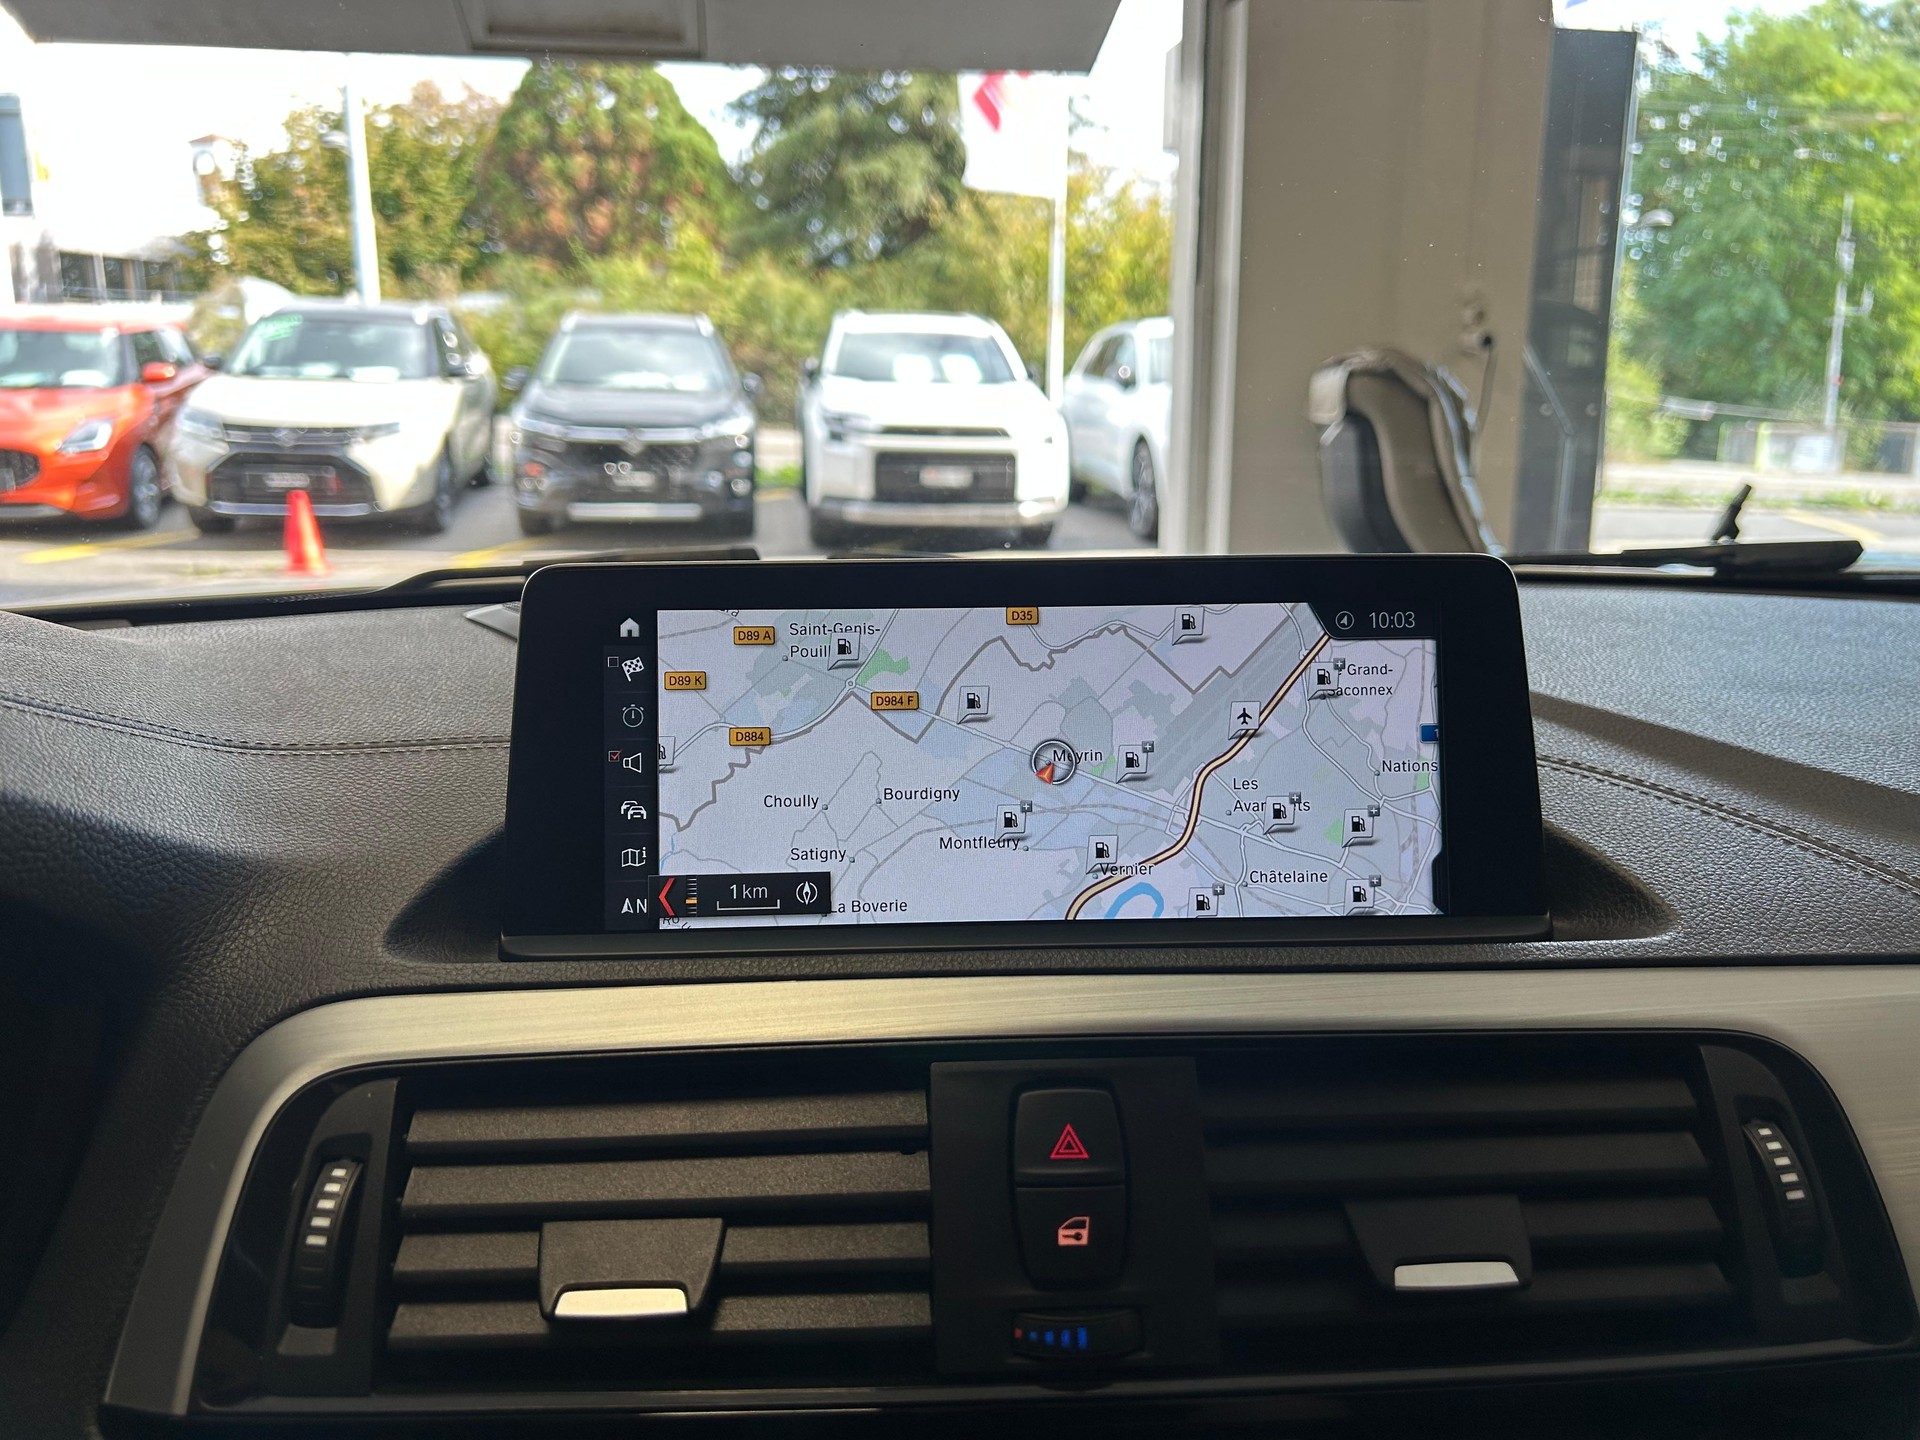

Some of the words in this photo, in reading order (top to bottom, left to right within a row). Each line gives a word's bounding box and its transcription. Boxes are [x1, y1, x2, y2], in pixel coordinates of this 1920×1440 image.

[1011, 610, 1033, 621] D35
[1368, 611, 1416, 629] 10:03
[738, 630, 760, 641] D89
[763, 630, 772, 641] A
[789, 622, 881, 636] Saint-Genis-
[790, 645, 831, 658] Pouill
[1347, 663, 1394, 676] Grand-
[669, 675, 691, 686] D89
[694, 675, 703, 686] K
[876, 695, 903, 706] D984
[907, 695, 915, 706] F
[735, 731, 764, 742] D884
[1053, 749, 1103, 765] Meyrin
[1382, 760, 1438, 772] Nations
[1233, 777, 1259, 790] Les
[883, 787, 960, 803] Bourdigny
[763, 795, 819, 810] Choully
[939, 837, 1020, 851] Montfleury
[790, 848, 847, 863] Satigny
[1100, 863, 1153, 875] Vernier
[1249, 870, 1329, 884] Châtelaine
[851, 899, 908, 913] Boverie
